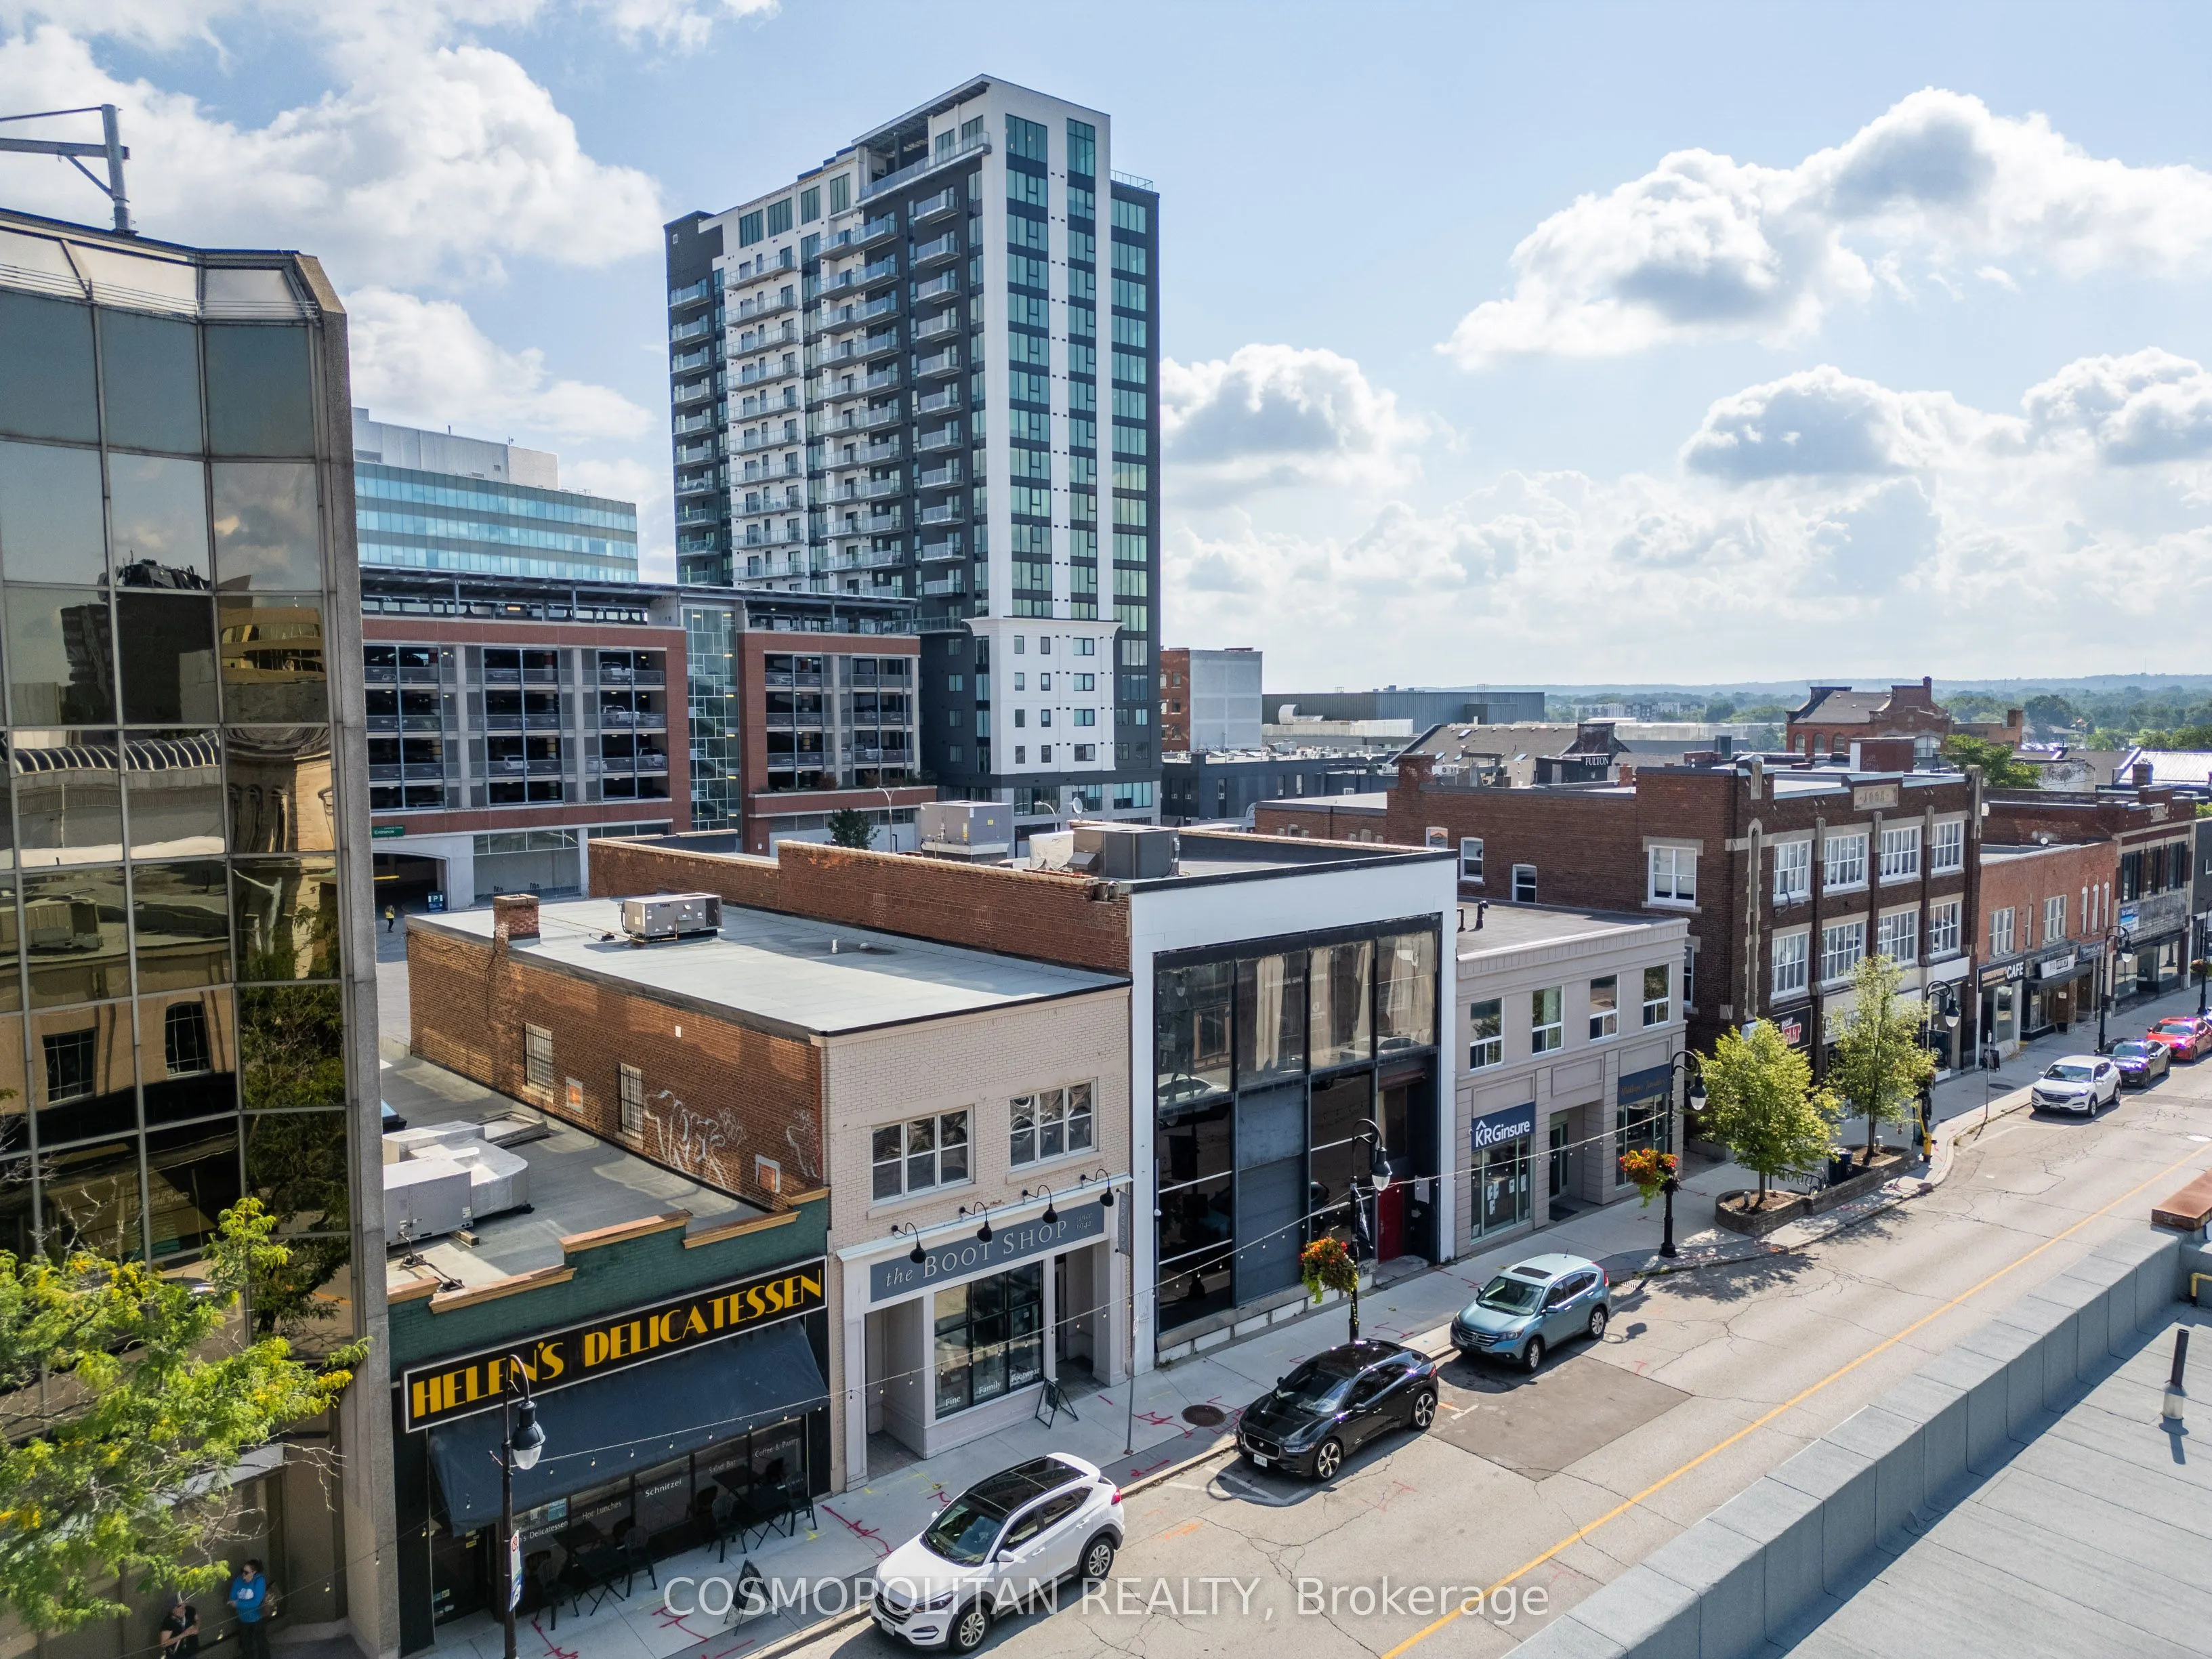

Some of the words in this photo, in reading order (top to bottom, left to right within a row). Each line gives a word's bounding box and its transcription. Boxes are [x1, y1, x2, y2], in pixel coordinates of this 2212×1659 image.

[1585, 756, 1609, 766] FULTON
[2006, 961, 2024, 980] CAFE
[1475, 1120, 1530, 1148] KRGinsure
[1076, 1221, 1091, 1230] 1942
[1077, 1213, 1093, 1221] since
[885, 1267, 913, 1287] the
[923, 1241, 993, 1278] BOOT
[1003, 1220, 1067, 1255] SHOP
[413, 1341, 564, 1419] HELEN'S
[584, 1269, 822, 1368] DELICATESSEN
[945, 1395, 961, 1406] Fine
[978, 1380, 1001, 1394] Family
[1011, 1367, 1040, 1382] Footwear
[755, 1447, 774, 1458] Coffee
[782, 1437, 799, 1449] Pastry
[709, 1463, 724, 1474] Salad
[726, 1459, 736, 1469] Bar
[644, 1478, 682, 1497] Schnitzel
[582, 1511, 593, 1520] Hot
[596, 1500, 622, 1515] Lunches
[529, 1520, 568, 1539] Delicatessen
